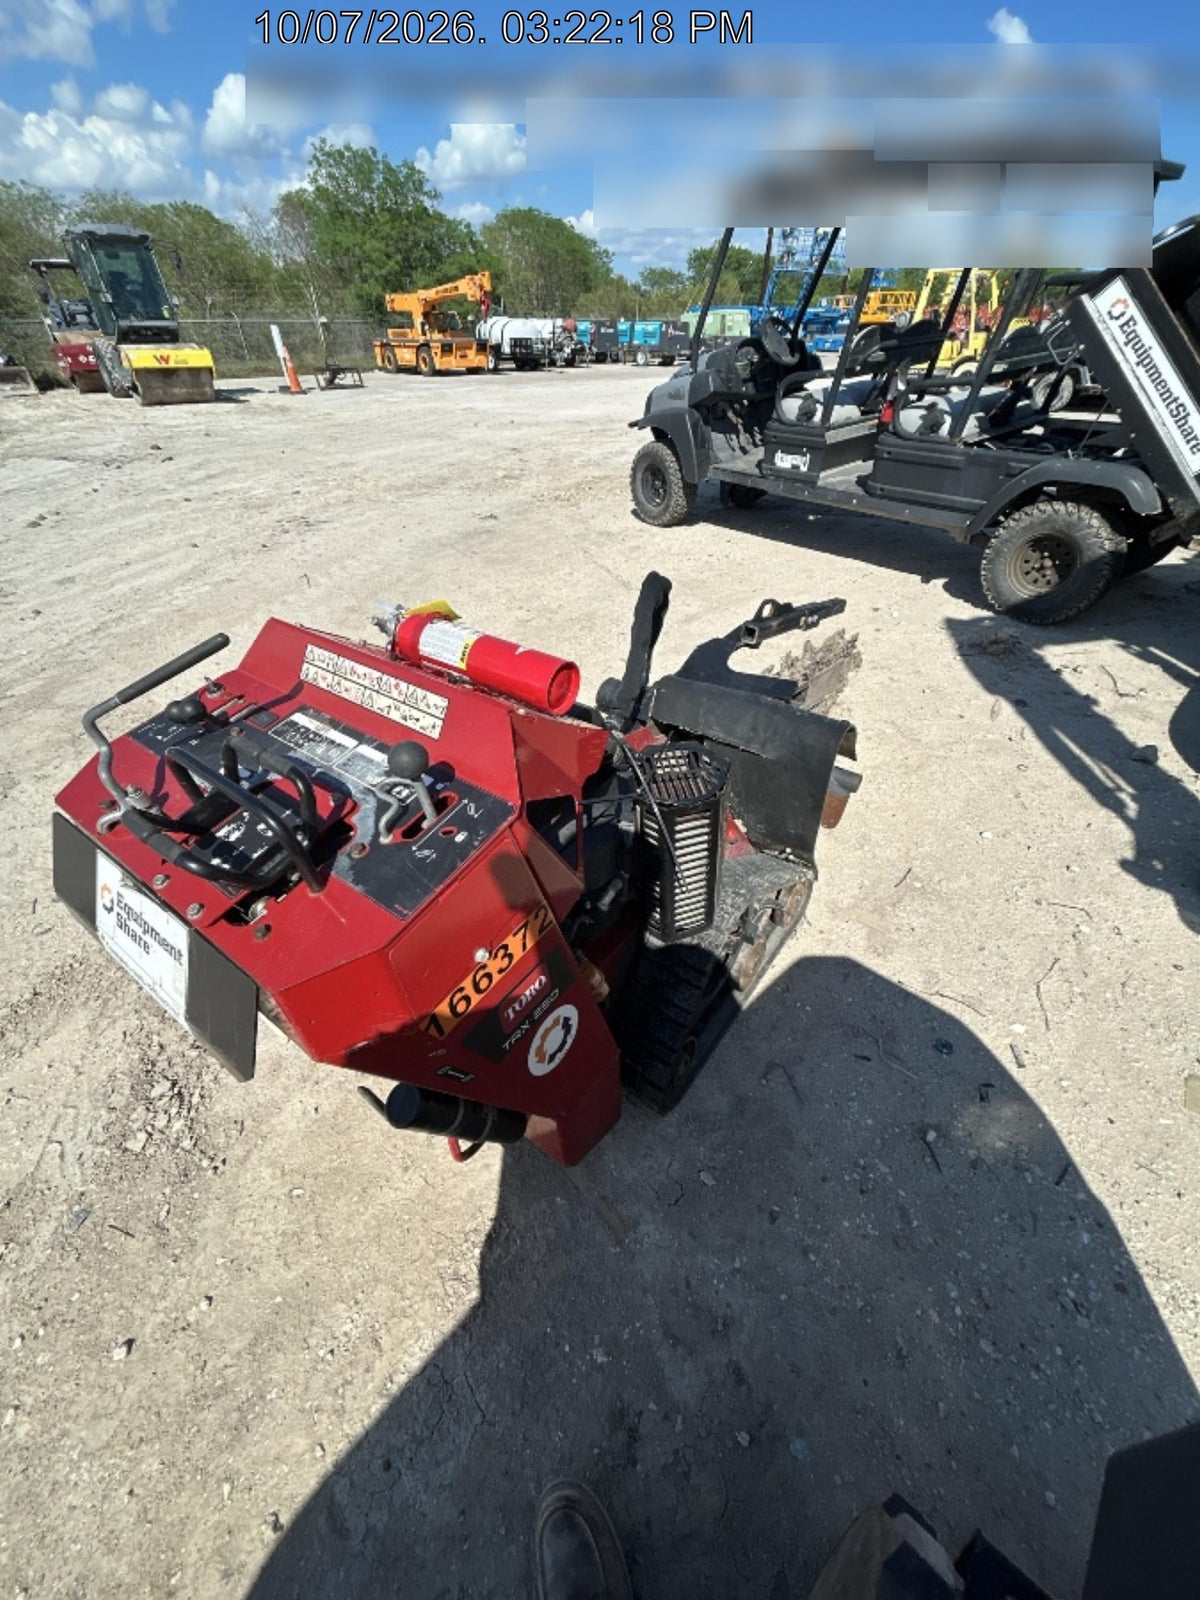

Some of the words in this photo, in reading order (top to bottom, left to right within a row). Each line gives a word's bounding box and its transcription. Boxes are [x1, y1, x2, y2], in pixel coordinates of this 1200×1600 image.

[1118, 314, 1200, 456] EquipmentShare
[115, 890, 184, 966] Equipment
[115, 913, 151, 956] Share
[424, 904, 554, 1039] 166372
[504, 974, 547, 1020] TORO
[502, 1019, 531, 1050] TRX
